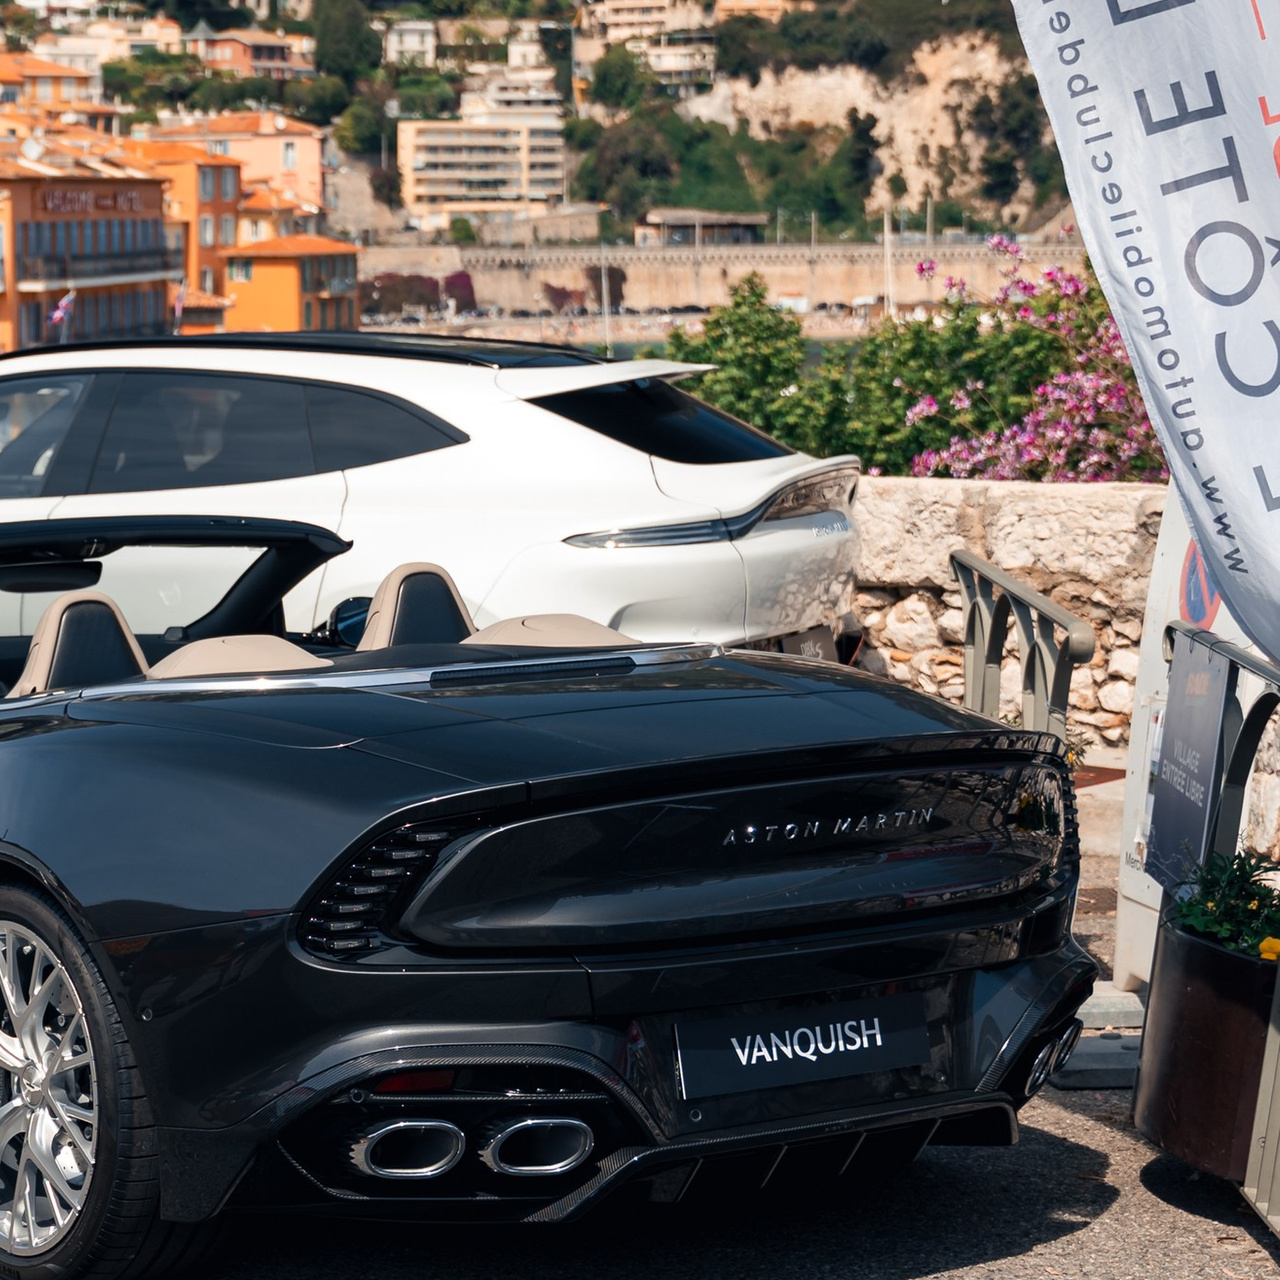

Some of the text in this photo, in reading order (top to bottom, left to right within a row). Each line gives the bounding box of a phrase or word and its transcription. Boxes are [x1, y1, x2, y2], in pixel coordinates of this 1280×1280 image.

[1173, 738, 1201, 773] VILLAGE
[1161, 759, 1205, 807] ENTRÉE LIBRE
[723, 807, 933, 846] ASTON MARTIN
[730, 1017, 883, 1066] VANQUISH
